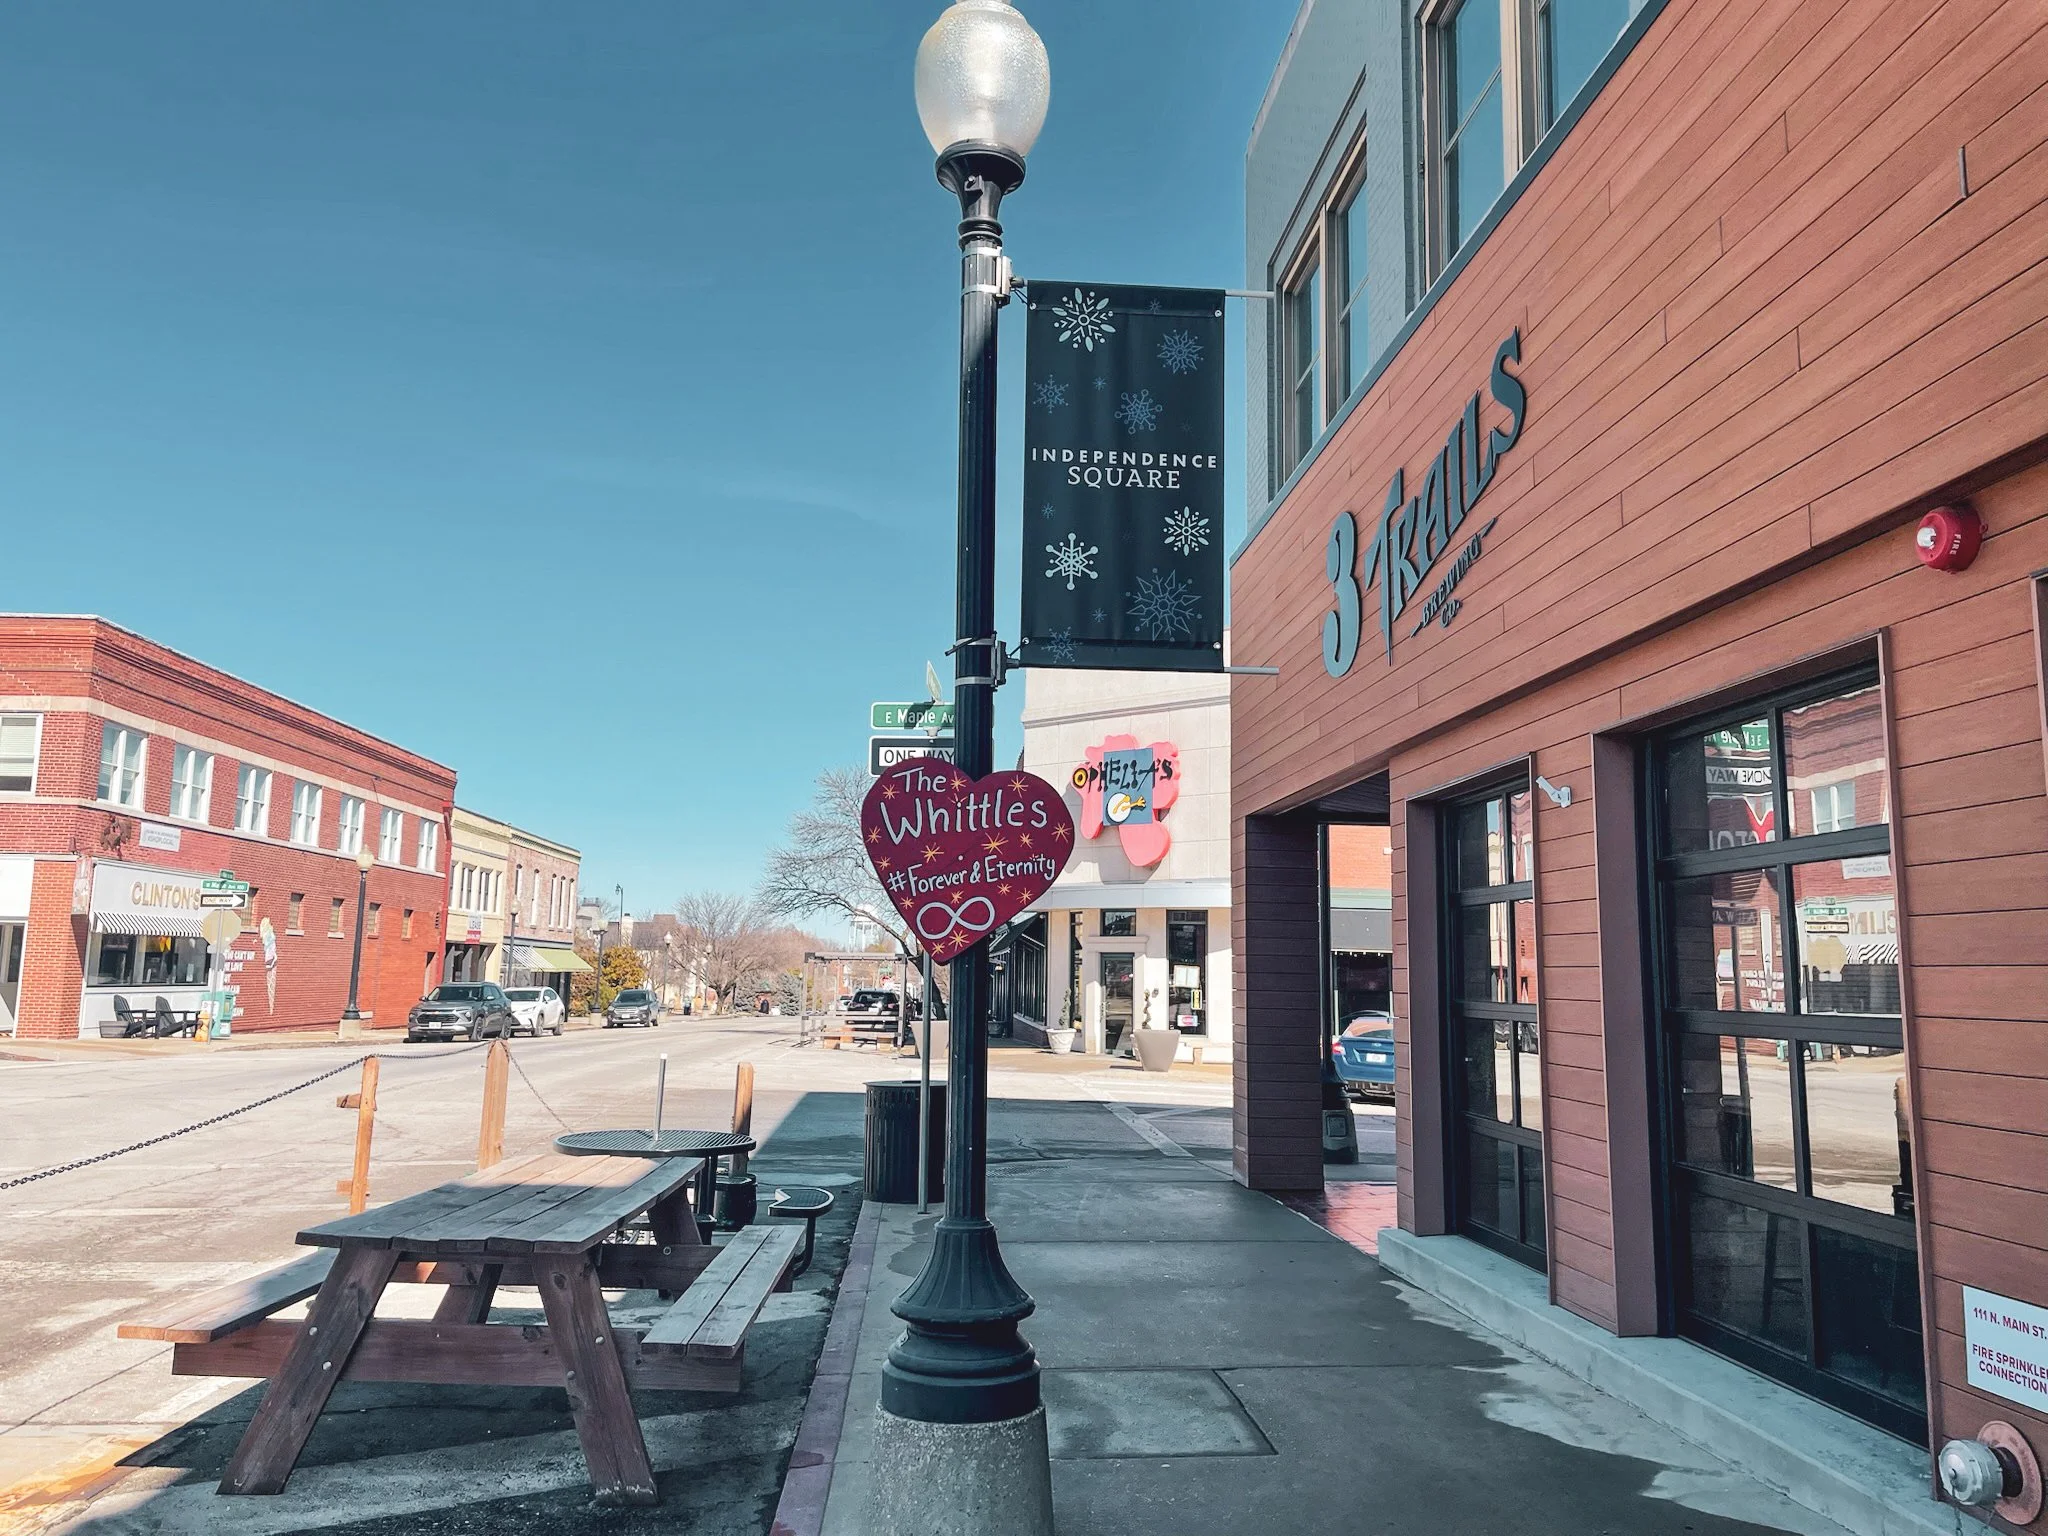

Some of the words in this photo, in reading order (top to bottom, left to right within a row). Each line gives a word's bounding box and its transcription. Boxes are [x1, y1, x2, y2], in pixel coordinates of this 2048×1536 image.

[1032, 447, 1217, 469] INDEPENDENCE
[1067, 466, 1180, 489] SQUARE
[1322, 510, 1361, 679] 3
[1364, 325, 1527, 667] TRAILS
[1950, 533, 1961, 555] FIRE
[1421, 533, 1482, 627] BREWING
[885, 711, 892, 723] E
[897, 708, 937, 728] Maple
[941, 711, 955, 724] Av
[892, 766, 946, 793] The
[1072, 757, 1173, 794] OPHELIA'S
[880, 789, 1048, 845] Whittles
[887, 863, 968, 897] #Forever
[969, 861, 981, 884] &
[984, 853, 1056, 881] Eternity
[131, 881, 201, 911] CLINTON'S
[1974, 1307, 1988, 1321] 111
[1990, 1312, 2000, 1325] N.
[2003, 1315, 2030, 1334] MAIN
[2032, 1325, 2047, 1340] ST.
[1972, 1343, 1994, 1360] FIRE
[1979, 1360, 2048, 1394] CONNECTION
